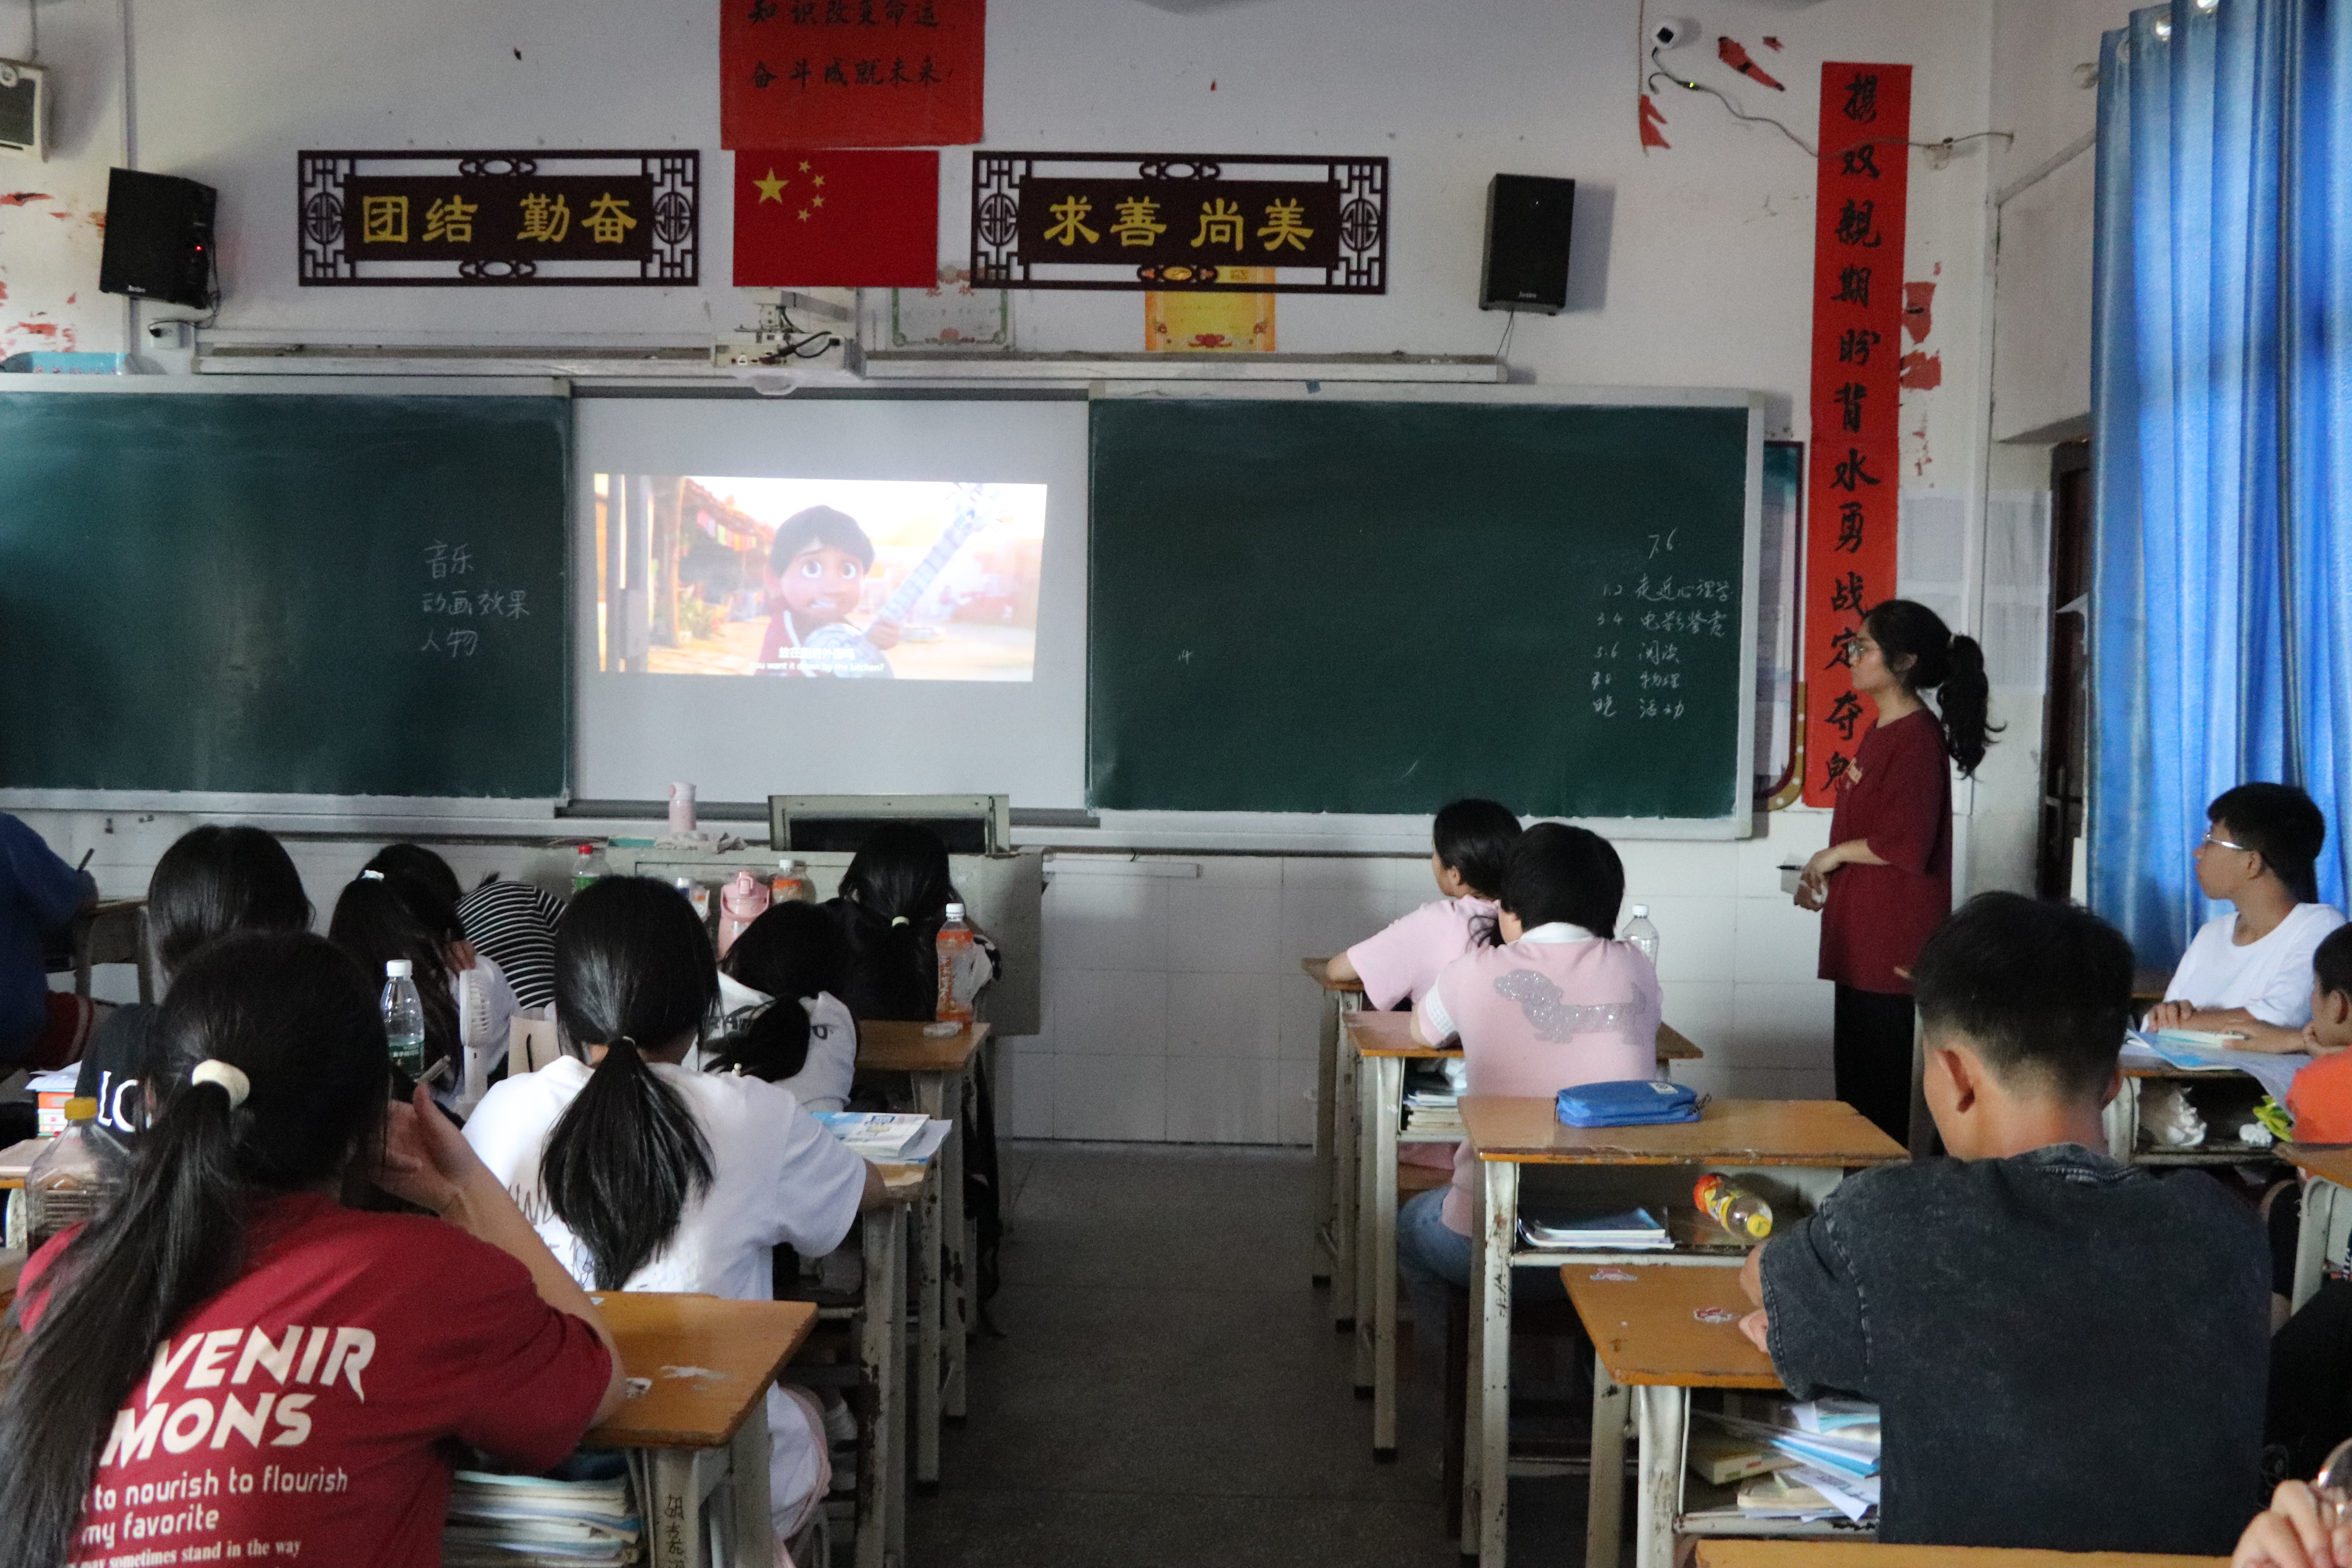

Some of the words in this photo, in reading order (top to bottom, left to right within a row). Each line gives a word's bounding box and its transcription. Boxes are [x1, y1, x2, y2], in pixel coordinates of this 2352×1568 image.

[424, 538, 474, 579] 音乐
[422, 590, 530, 619] 动画效果
[421, 628, 478, 658] 人物
[822, 662, 832, 673] by
[834, 663, 849, 671] the
[1640, 698, 1685, 720] 活动
[94, 1484, 116, 1512] to
[125, 1468, 220, 1506] nourish
[229, 1466, 253, 1494] to
[263, 1465, 348, 1493] flourish
[82, 1522, 116, 1549] my
[122, 1503, 220, 1540] favorite
[109, 1548, 177, 1568] sometimes
[181, 1541, 222, 1562] stand
[226, 1540, 241, 1558] in
[247, 1537, 270, 1557] the
[275, 1541, 301, 1558] way
